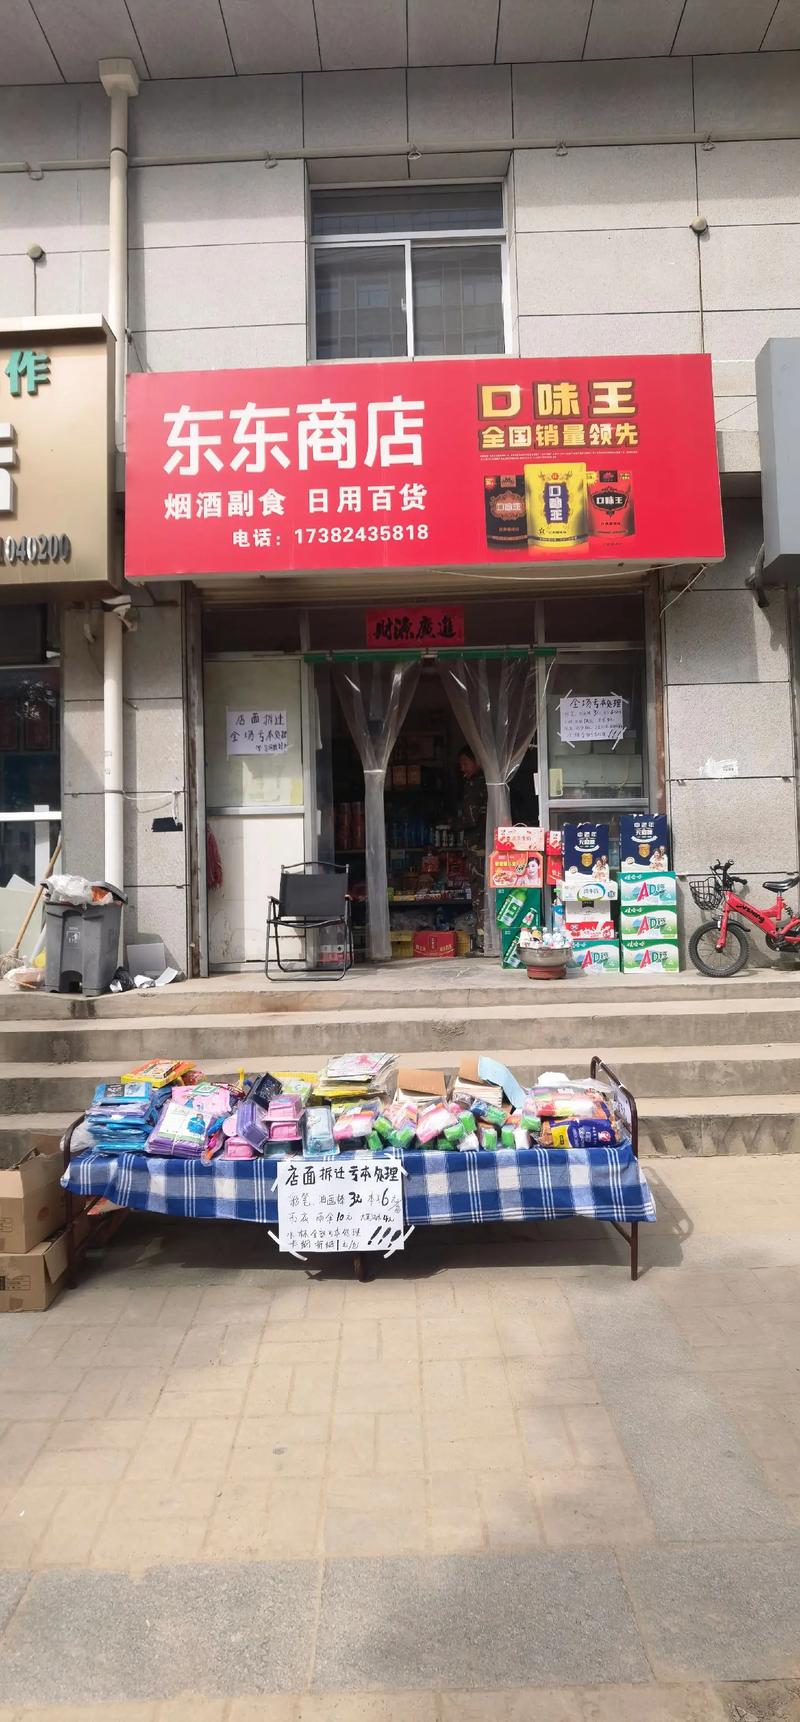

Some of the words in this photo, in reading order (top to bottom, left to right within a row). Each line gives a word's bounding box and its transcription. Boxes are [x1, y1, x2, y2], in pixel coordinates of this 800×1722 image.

[5, 348, 50, 396] 作
[479, 381, 637, 419] 口味王
[163, 396, 426, 476] 东东商店
[481, 422, 639, 448] 全国销量领先
[164, 488, 287, 521] 烟酒副食
[308, 483, 428, 514] 日用百货
[596, 495, 623, 505] 口味王
[295, 524, 430, 545] 17382435818
[285, 1164, 400, 1186] 店面拆迁亏本处理
